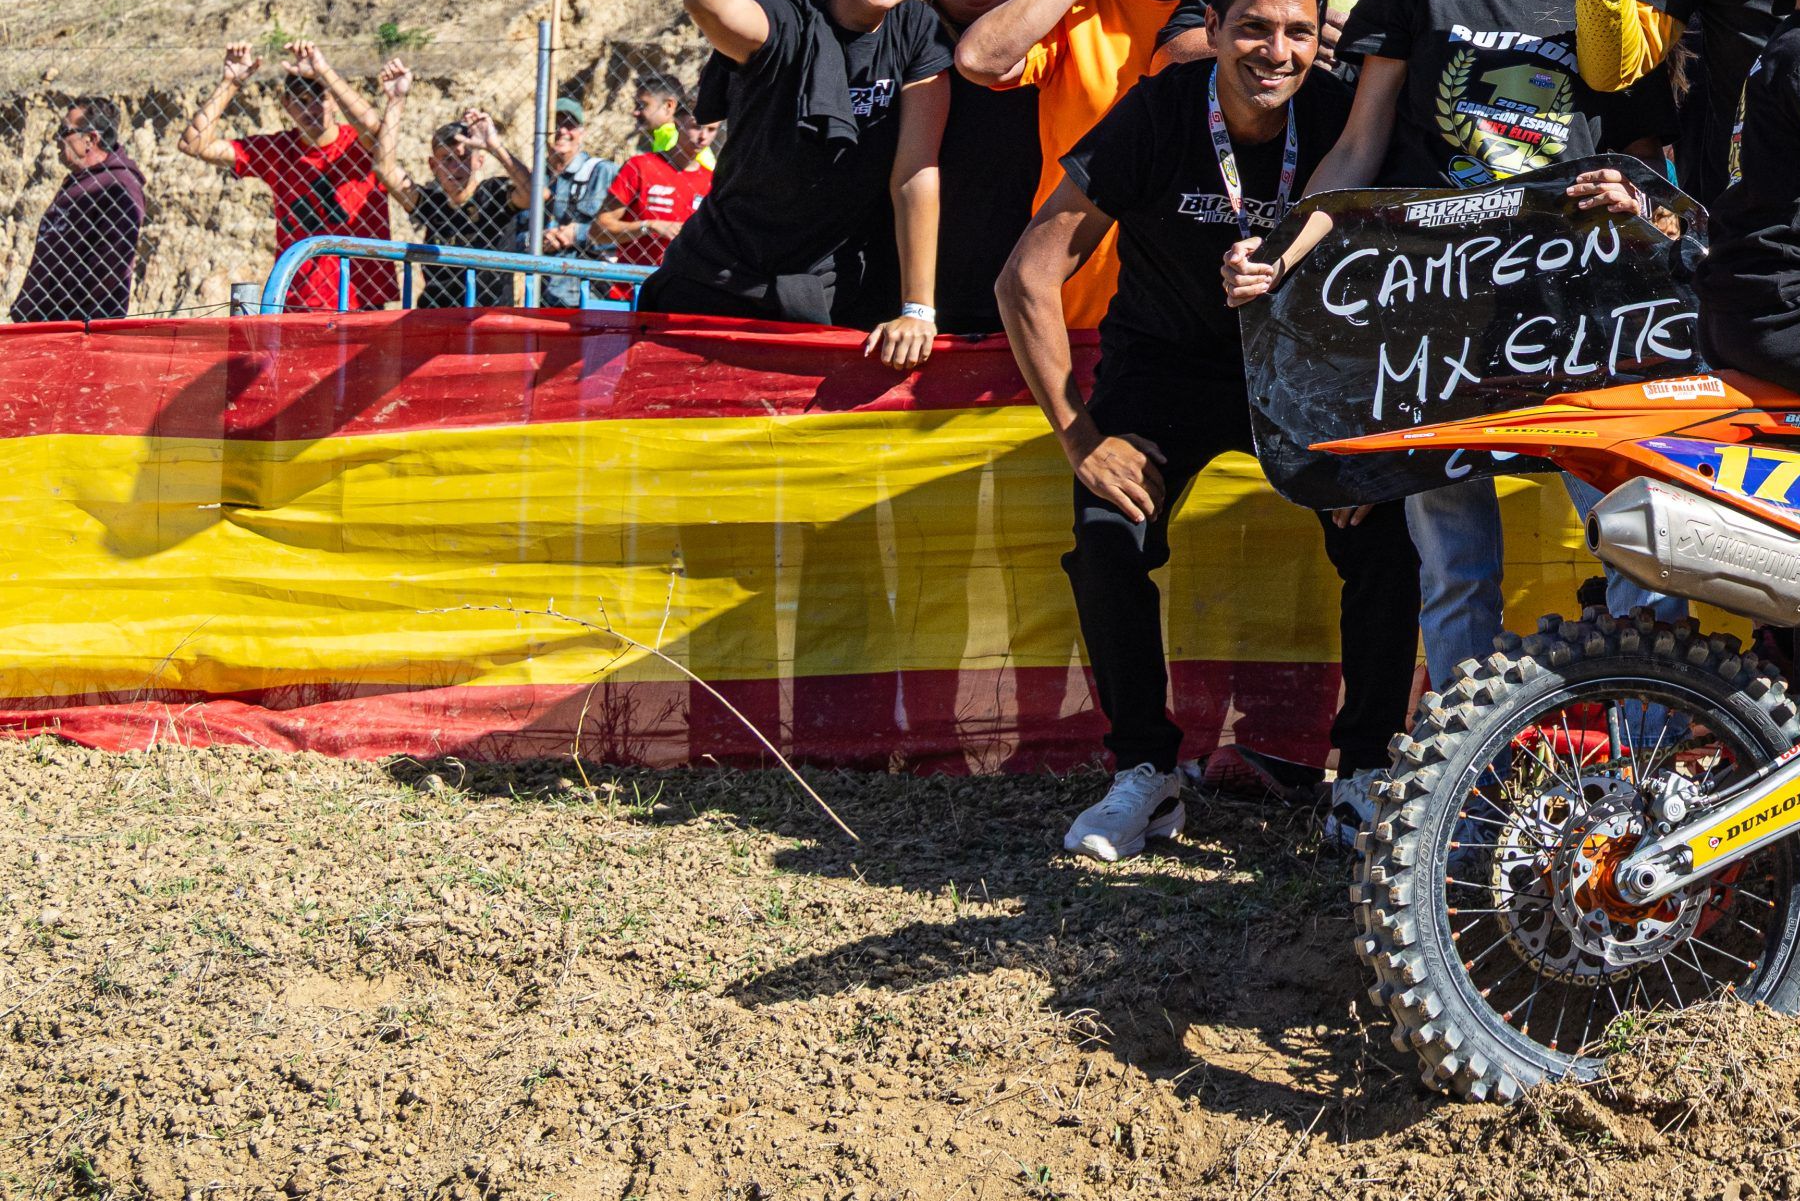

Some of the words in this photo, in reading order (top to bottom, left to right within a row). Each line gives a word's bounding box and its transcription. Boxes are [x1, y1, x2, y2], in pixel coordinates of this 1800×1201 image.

[1322, 220, 1621, 317] CAMPEON
[1373, 335, 1481, 421] MX
[1505, 298, 1699, 376] ELITE
[1648, 383, 1669, 395] SELLE
[1672, 383, 1696, 393] DALLA
[1697, 381, 1721, 393] VALLE
[1504, 428, 1596, 436] DUNLOP
